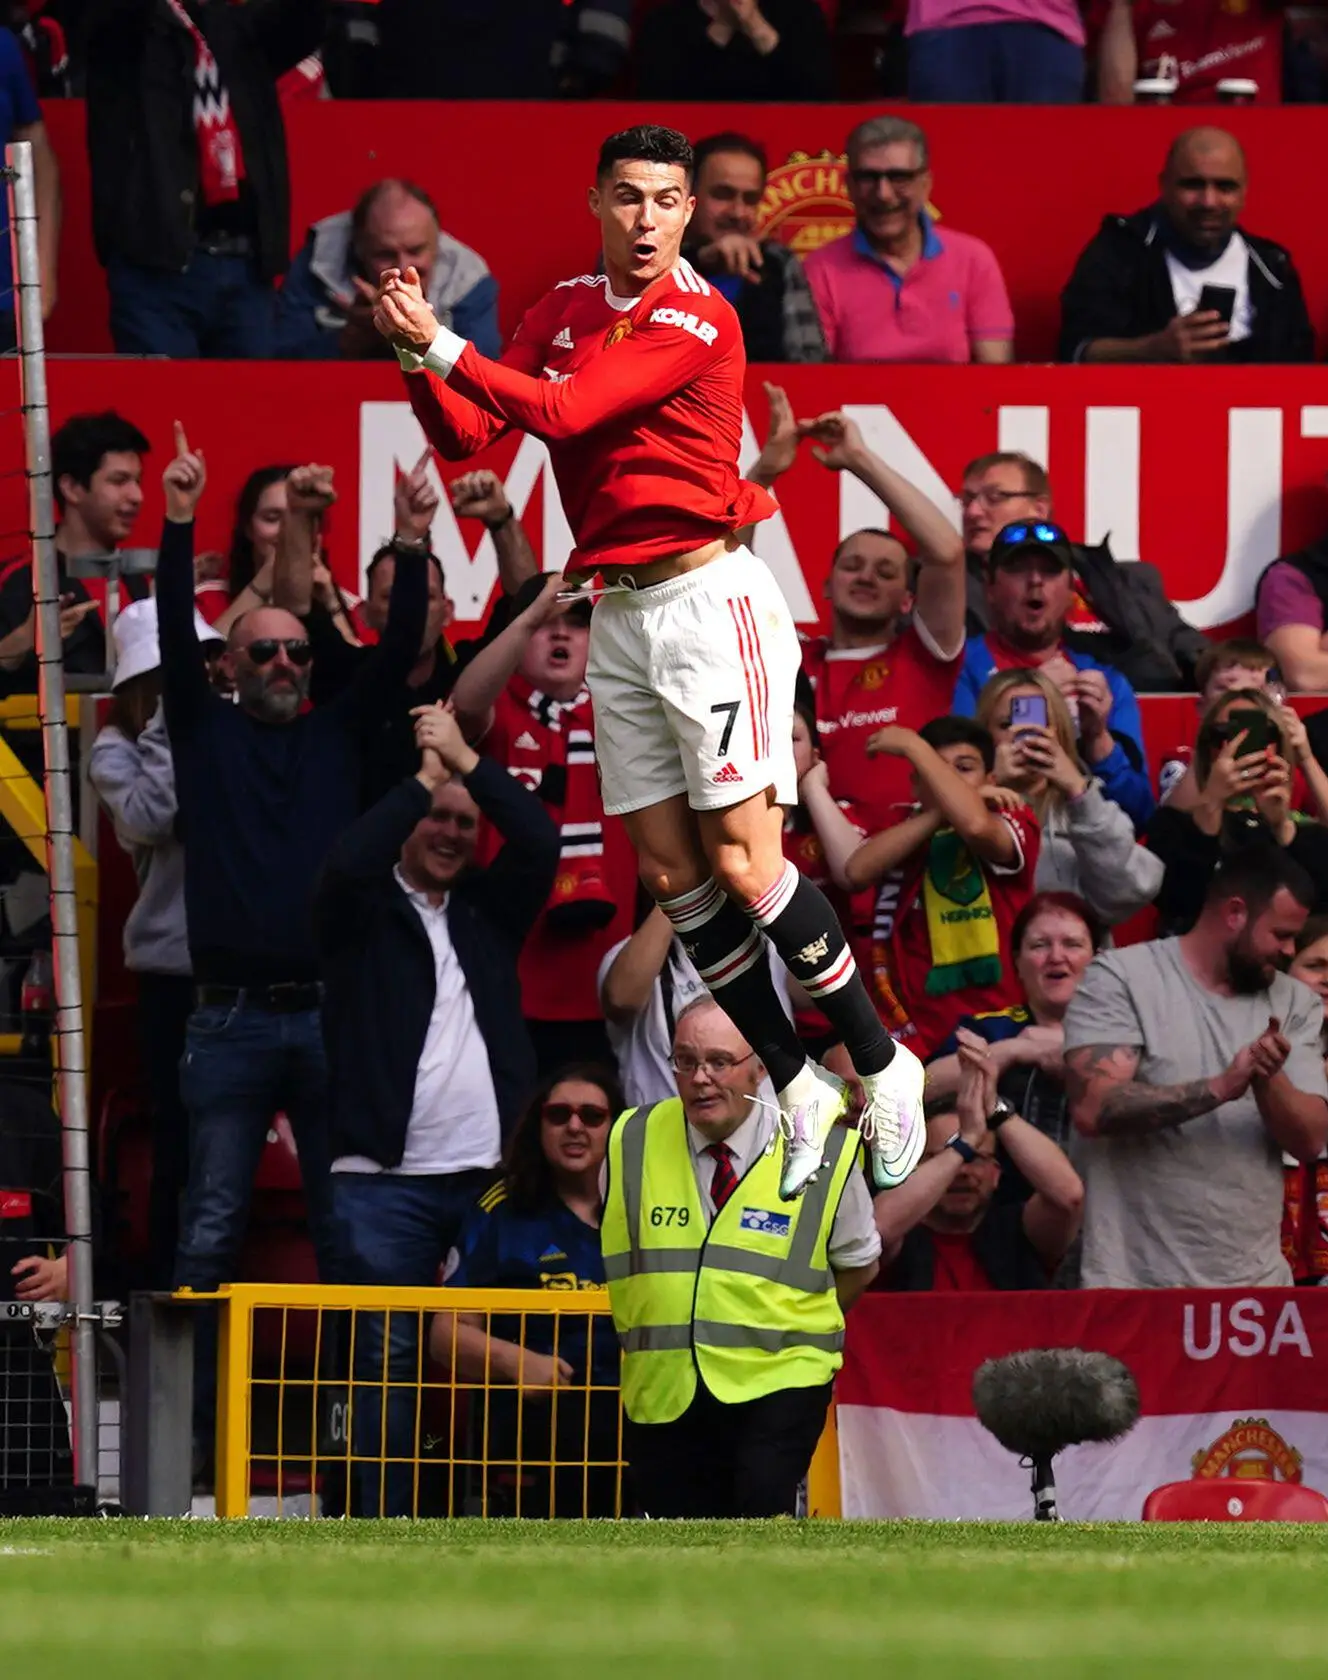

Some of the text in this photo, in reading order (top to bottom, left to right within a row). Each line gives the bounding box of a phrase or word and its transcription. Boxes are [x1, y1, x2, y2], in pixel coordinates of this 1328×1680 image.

[650, 307, 718, 346] KOHLER
[710, 700, 741, 756] 7
[712, 775, 743, 783] adidas
[650, 1206, 690, 1227] 679
[762, 1220, 789, 1236] CSG
[1183, 1297, 1314, 1361] USA
